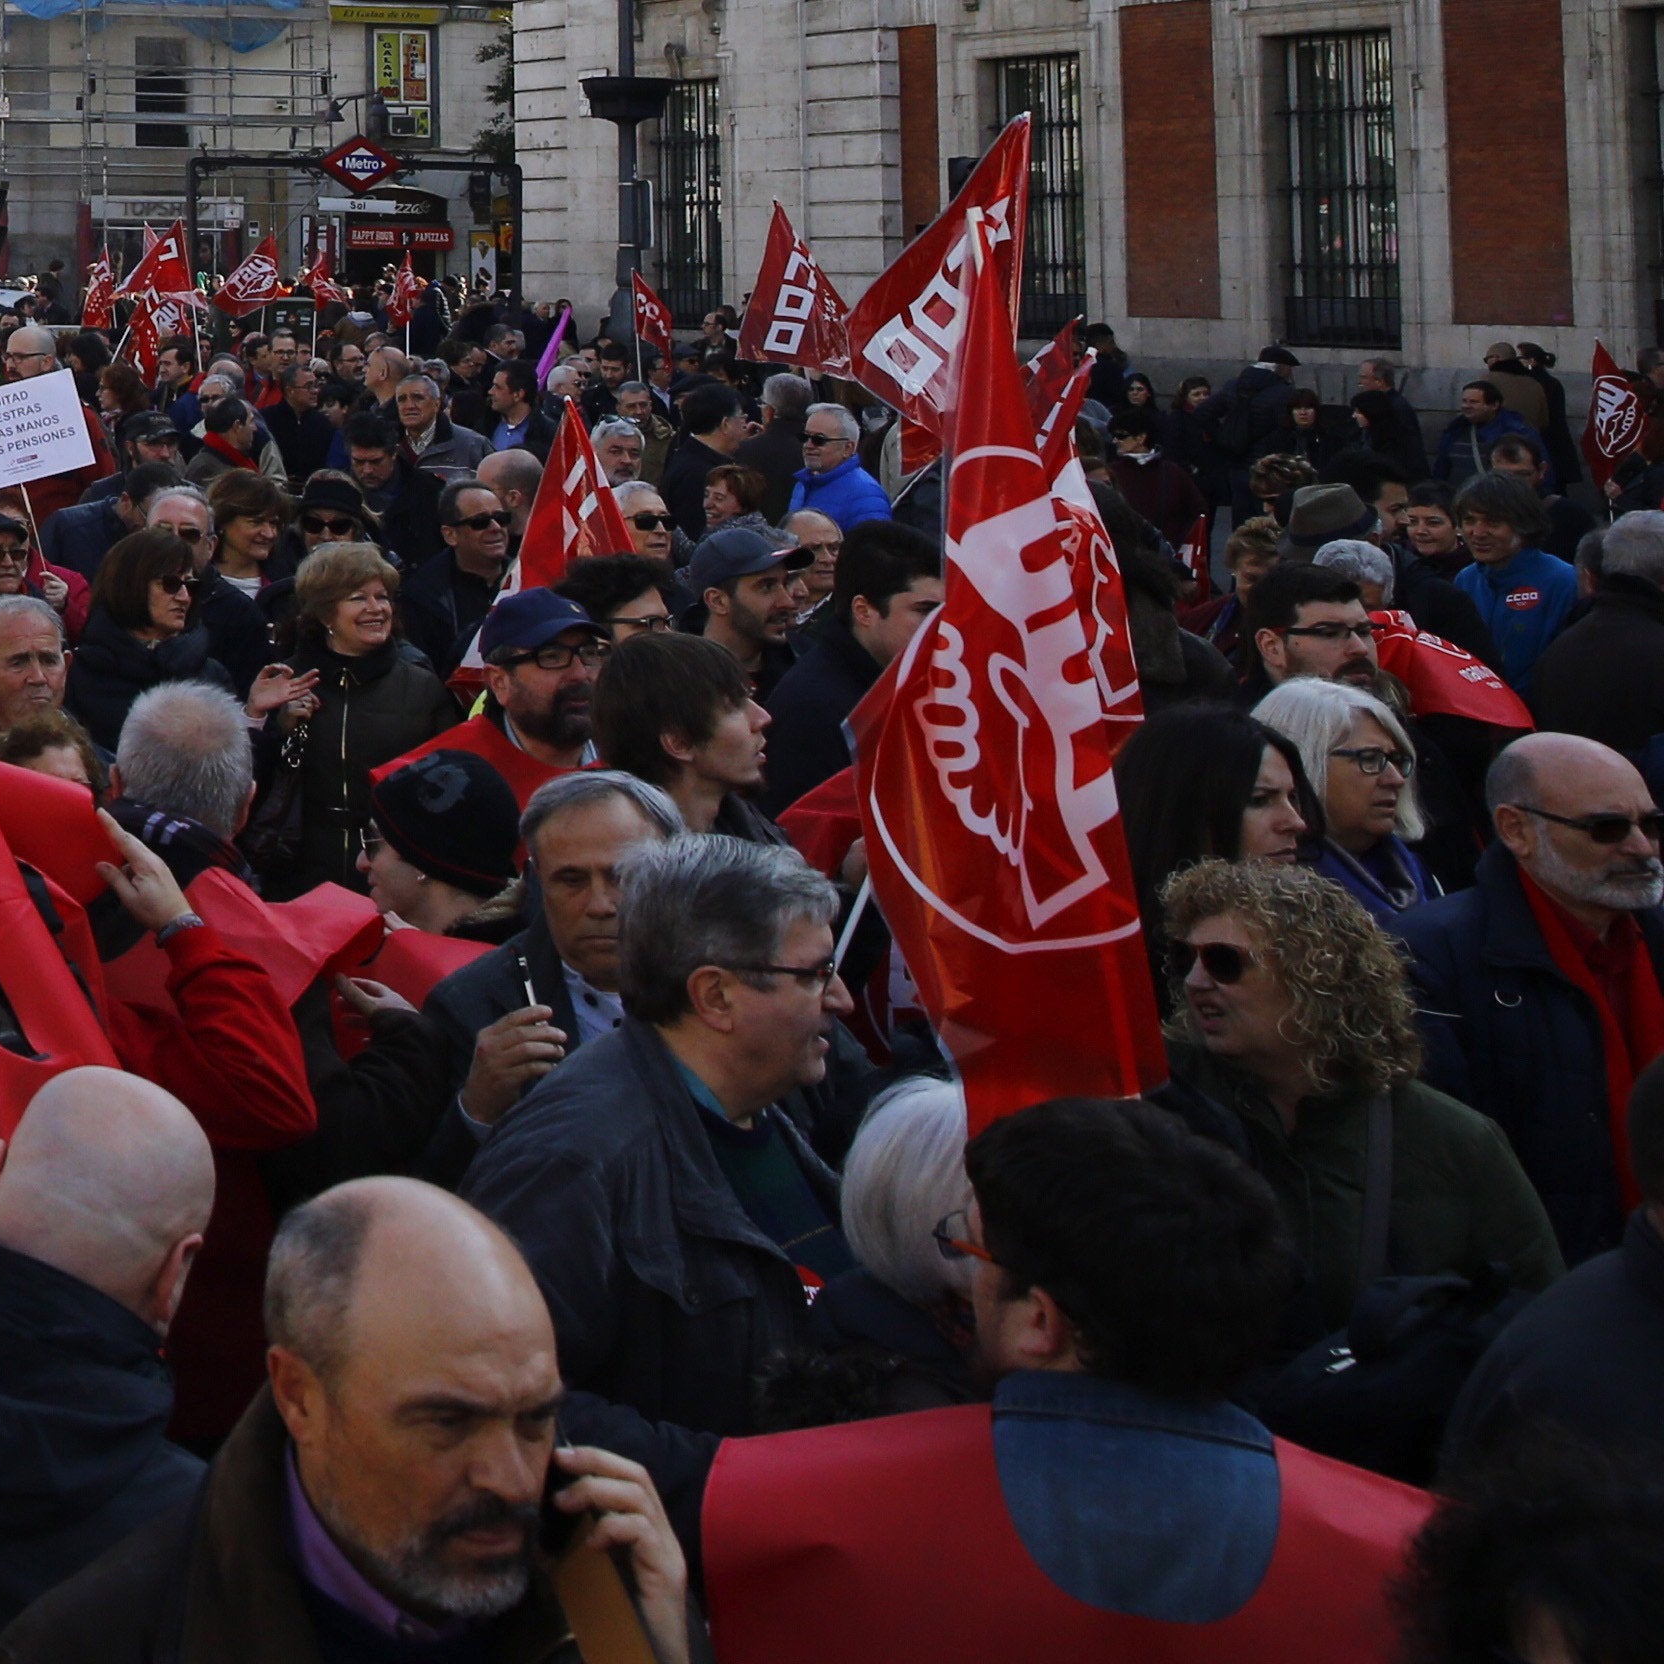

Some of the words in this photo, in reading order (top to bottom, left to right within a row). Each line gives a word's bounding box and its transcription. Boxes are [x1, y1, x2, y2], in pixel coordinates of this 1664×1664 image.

[345, 157, 379, 170] Metro
[123, 202, 210, 216] TOPSHP
[350, 200, 366, 211] Sol
[351, 230, 374, 241] HAPPY
[375, 231, 394, 242] HOUR
[415, 232, 449, 243] PAPIZZAS
[15, 414, 60, 434] MANOS
[7, 426, 76, 452] PENSIONES
[1505, 592, 1539, 603] CCOO
